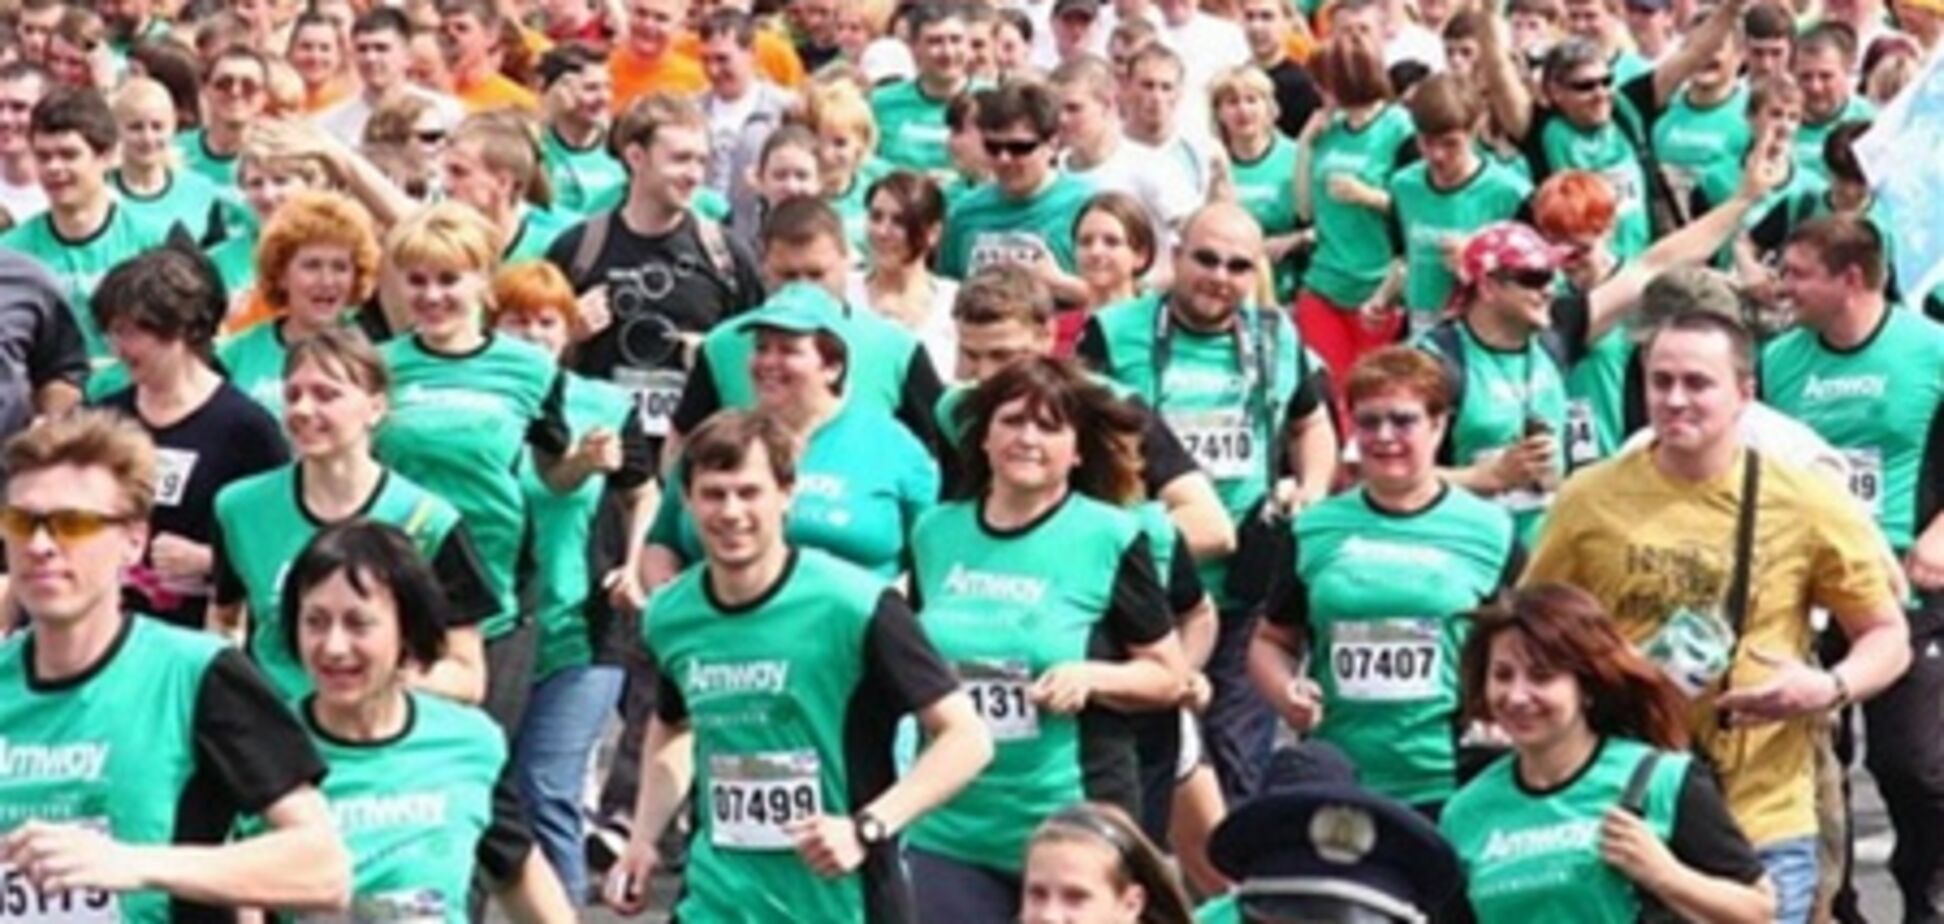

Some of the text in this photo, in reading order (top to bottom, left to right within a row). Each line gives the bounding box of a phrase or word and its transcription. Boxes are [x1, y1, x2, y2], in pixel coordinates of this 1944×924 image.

[1184, 431, 1252, 460] 7410
[944, 562, 1048, 605] Amway
[684, 657, 790, 695] Amway
[1337, 646, 1435, 680] 07407
[969, 685, 1025, 718] 131
[713, 785, 816, 825] 07499
